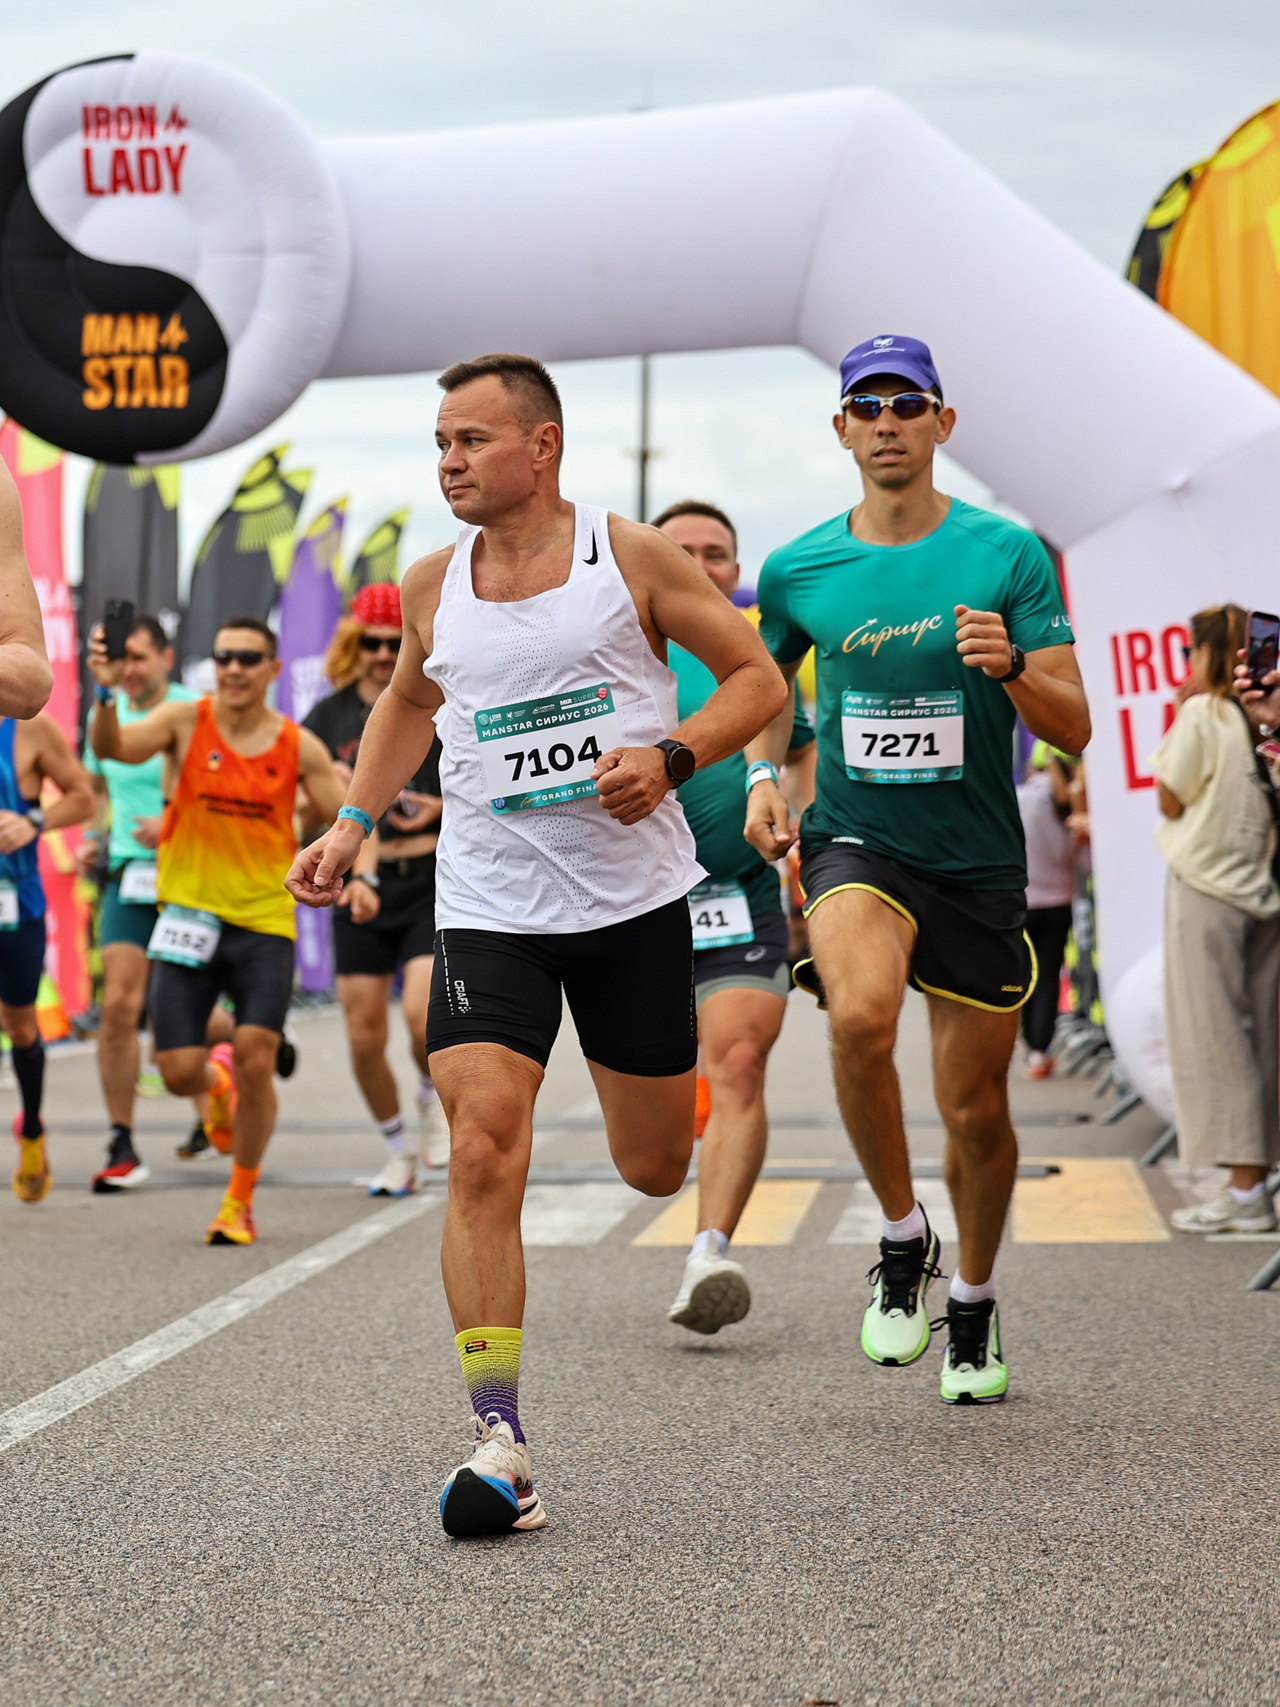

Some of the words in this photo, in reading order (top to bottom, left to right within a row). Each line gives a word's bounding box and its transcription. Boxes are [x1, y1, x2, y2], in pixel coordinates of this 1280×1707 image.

[82, 105, 156, 141] IRON
[82, 144, 187, 196] LADY
[82, 313, 159, 356] MAN
[82, 355, 189, 410] STAR
[841, 614, 942, 657] Сириус
[1110, 625, 1193, 696] IRO
[573, 692, 597, 703] SUPRE
[845, 707, 887, 716] MANSTAR
[890, 708, 931, 717] СИРИУС
[933, 706, 958, 715] 2026
[482, 720, 533, 738] MANSTAR
[535, 710, 581, 727] СИРИУС
[584, 703, 609, 716] 2026
[504, 735, 602, 781] 7104
[861, 732, 940, 757] 7271
[541, 788, 574, 801] GRAND
[696, 910, 729, 928] 41
[454, 979, 470, 1007] CRAFT
